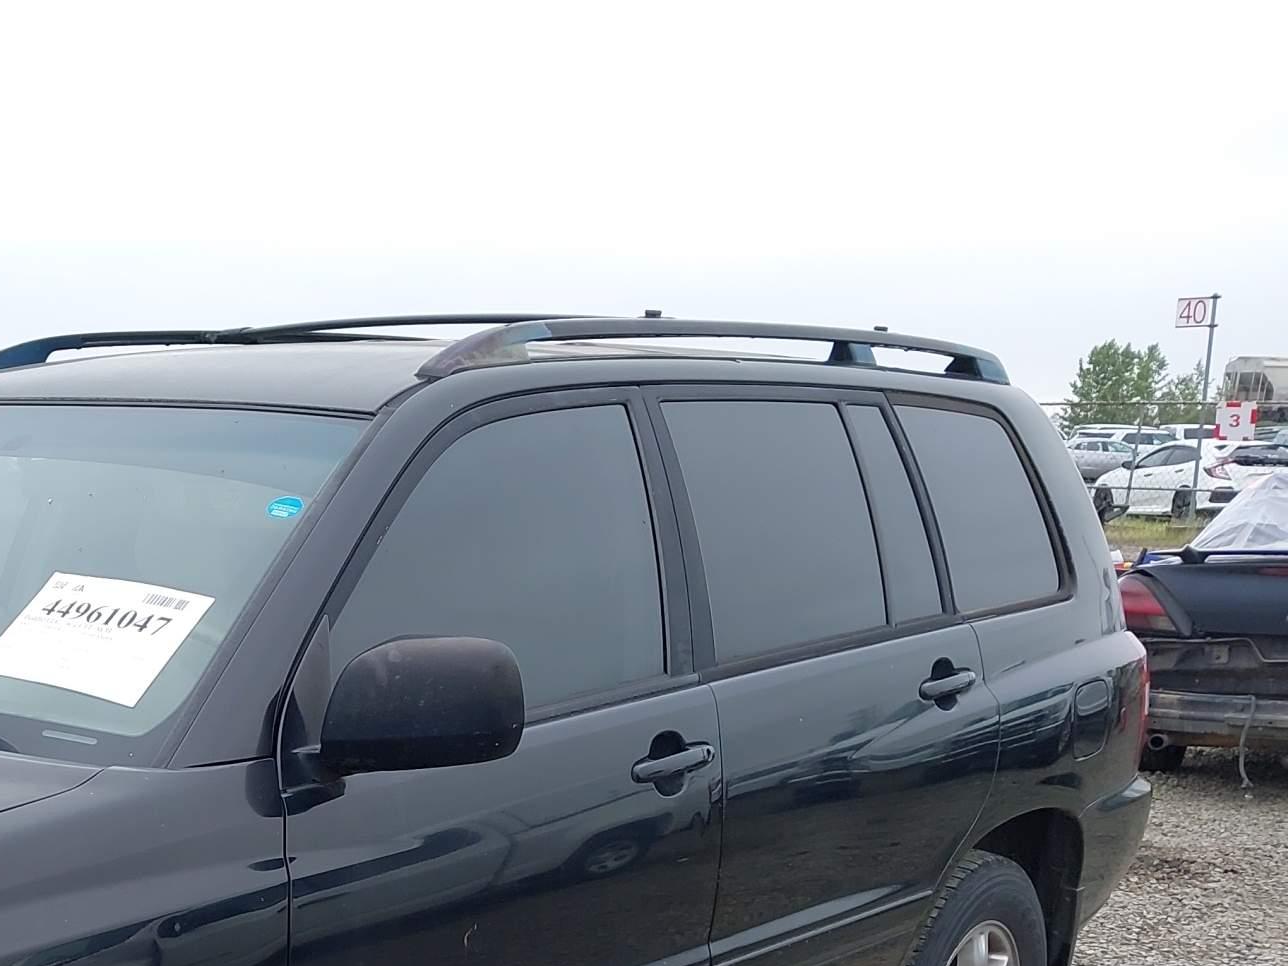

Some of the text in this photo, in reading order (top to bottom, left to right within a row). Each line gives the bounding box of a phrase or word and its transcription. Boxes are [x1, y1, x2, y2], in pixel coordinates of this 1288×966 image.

[1179, 300, 1207, 324] 40
[1229, 414, 1241, 427] 3
[41, 599, 173, 636] 44961047
